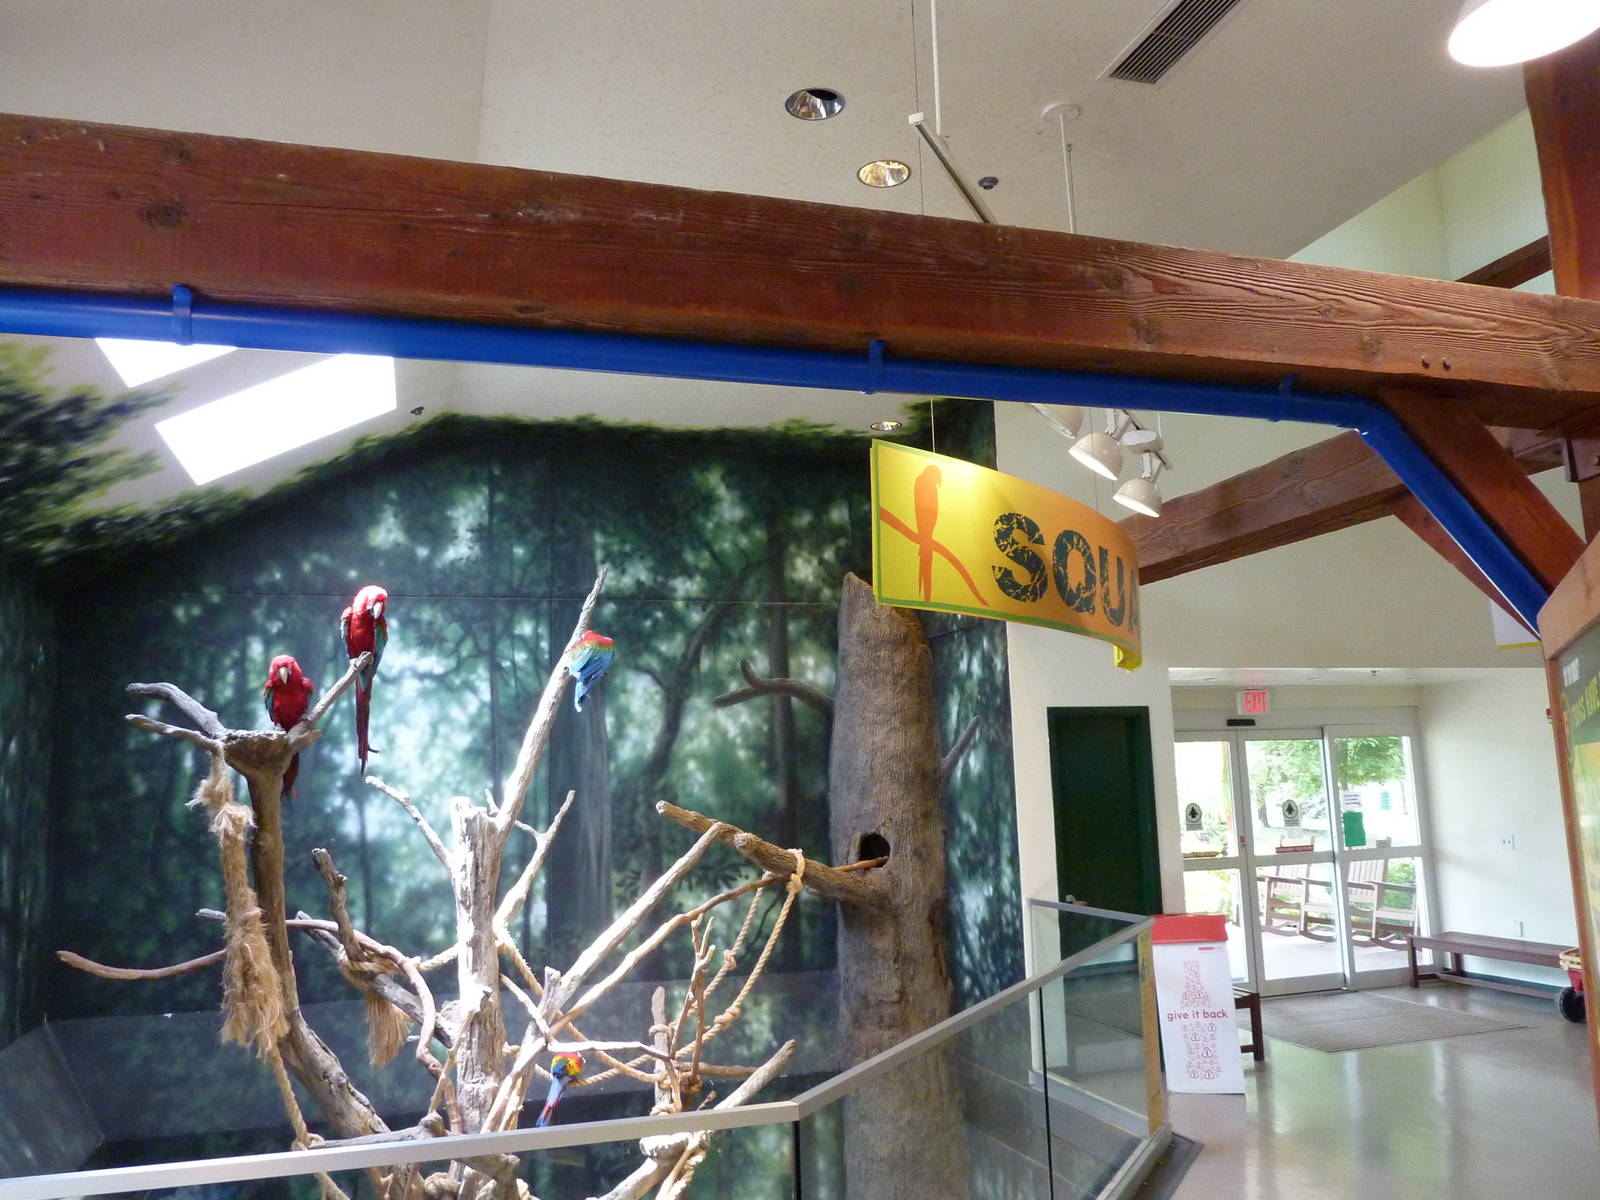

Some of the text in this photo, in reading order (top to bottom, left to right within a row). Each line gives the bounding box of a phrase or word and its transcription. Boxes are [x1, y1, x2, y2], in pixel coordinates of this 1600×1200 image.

[1244, 691, 1267, 712] EXIT
[1167, 1009, 1228, 1022] give it back
